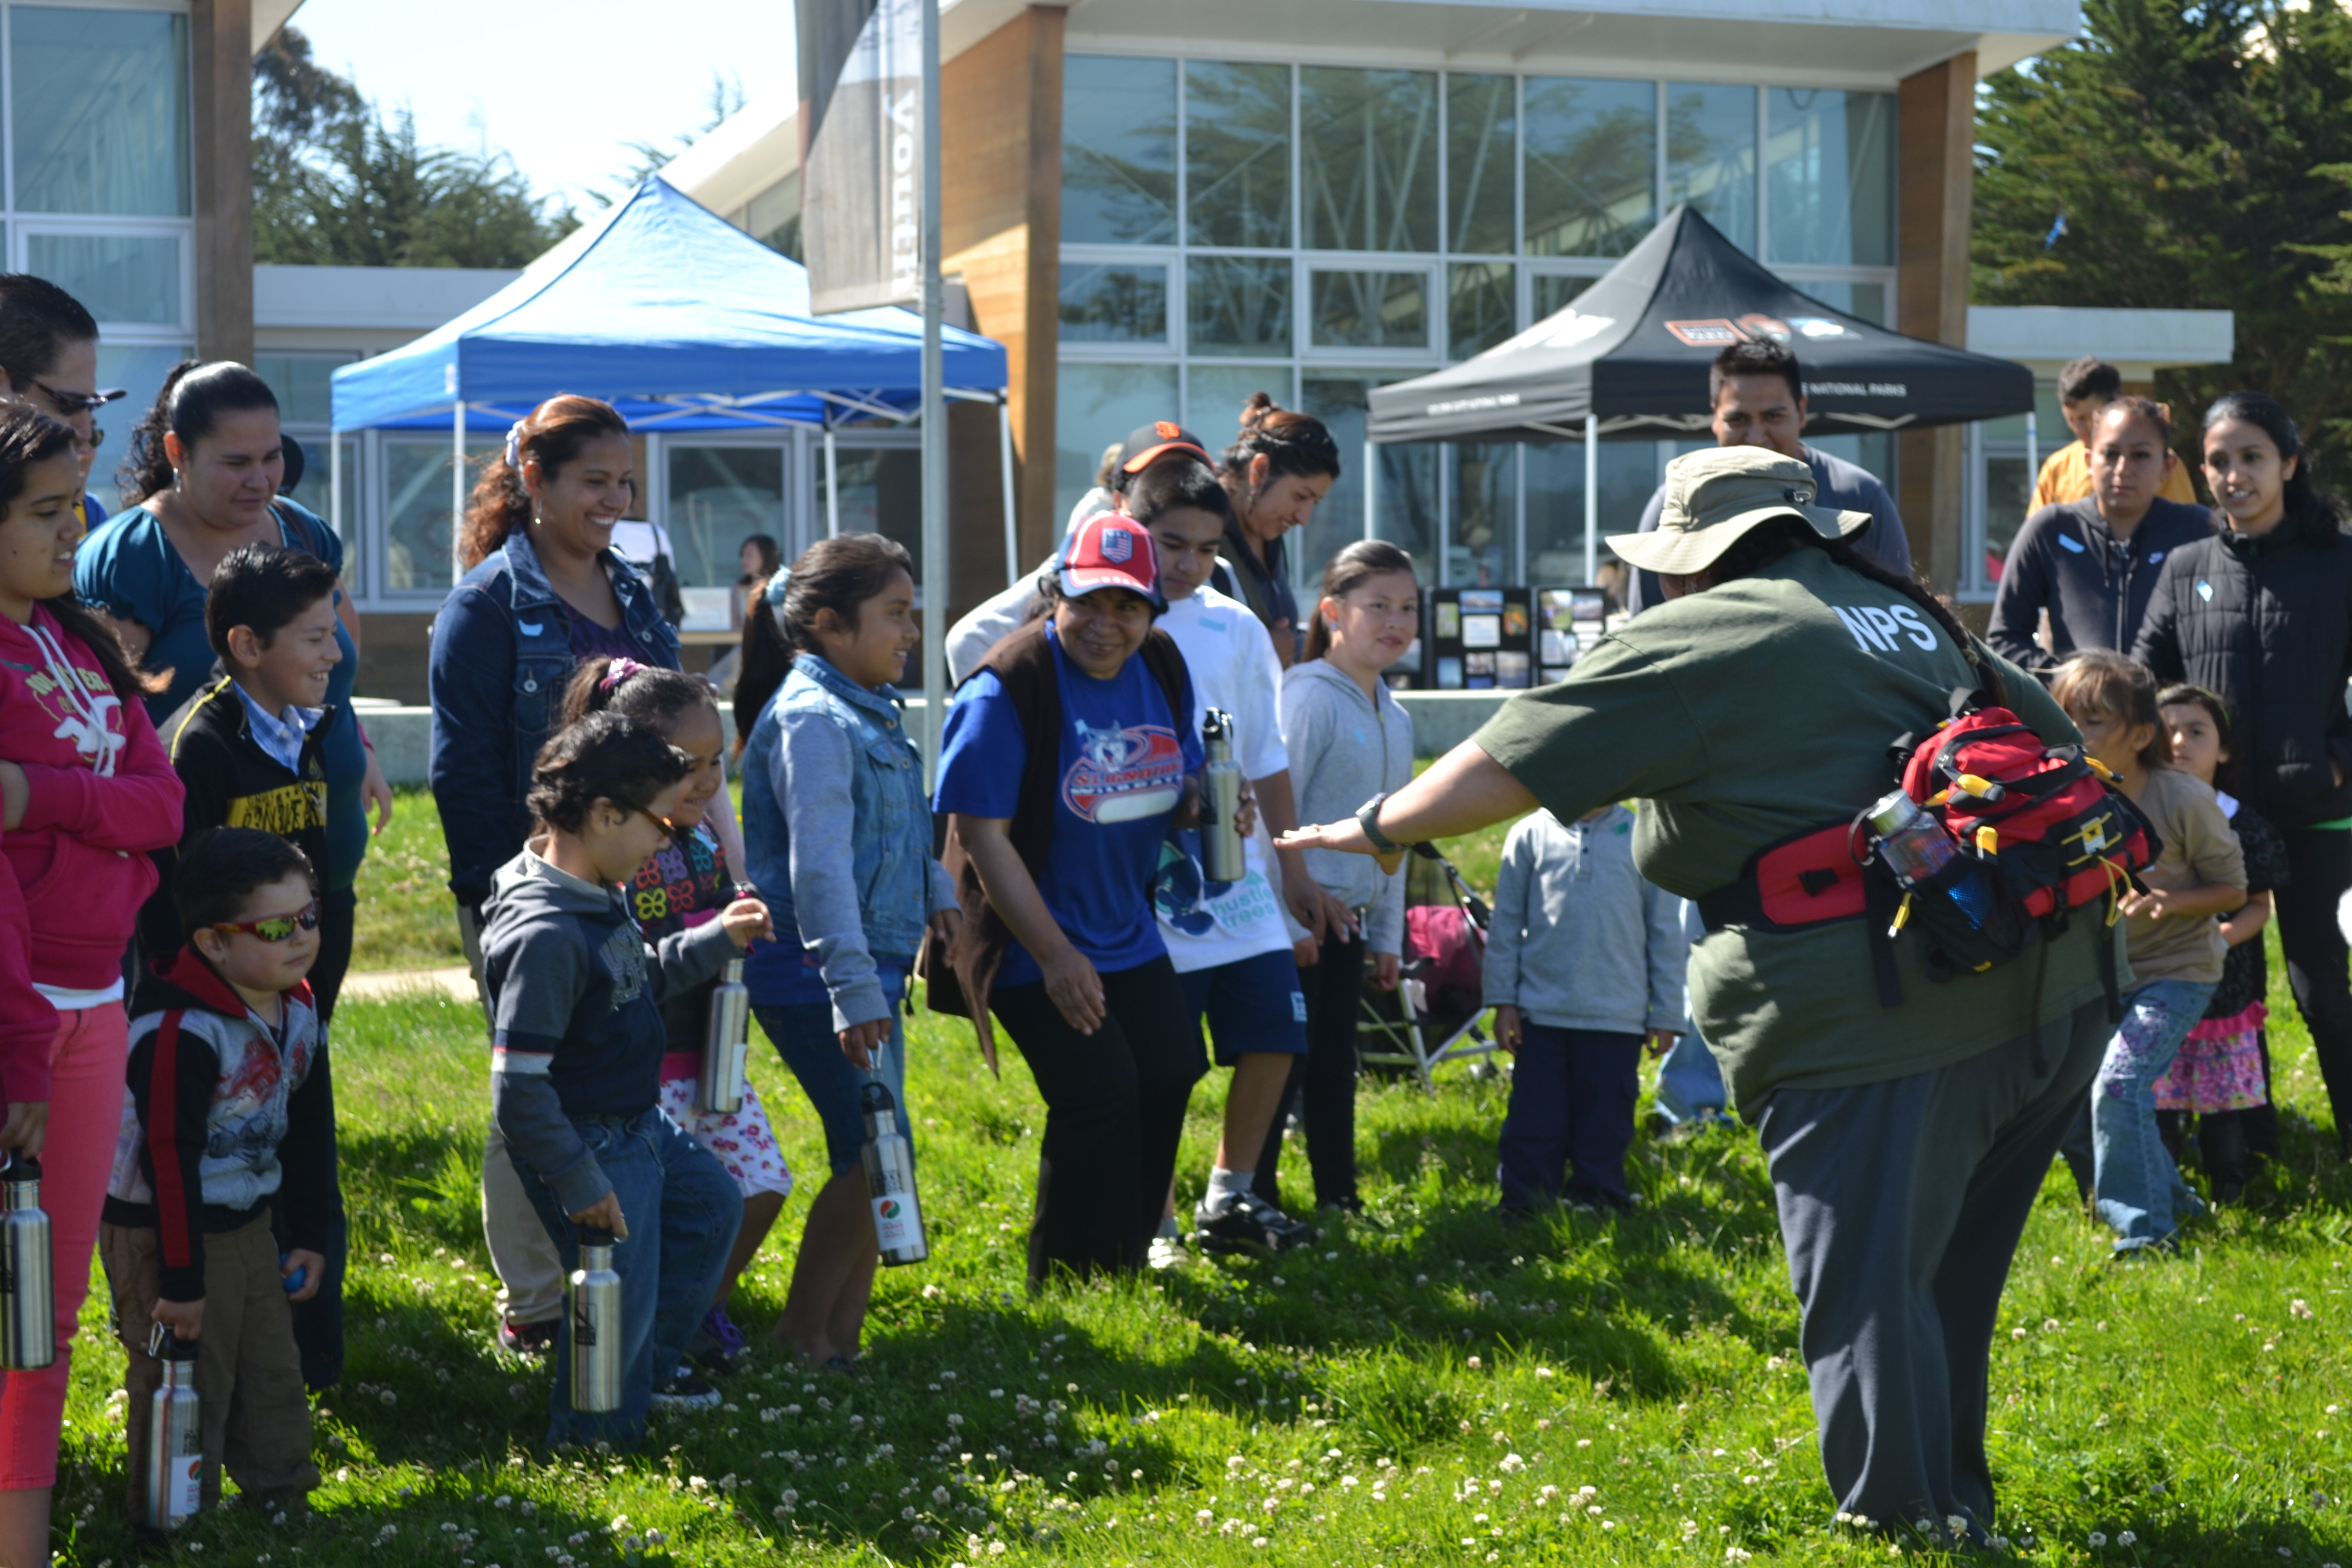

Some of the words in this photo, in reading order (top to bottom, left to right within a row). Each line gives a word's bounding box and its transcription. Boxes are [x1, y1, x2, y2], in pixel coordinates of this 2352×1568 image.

[884, 89, 919, 296] youth
[1810, 382, 1867, 397] NATIONAL
[1868, 383, 1908, 398] PARKS
[1831, 604, 1938, 652] NPS
[1211, 877, 1273, 918] hustle
[1221, 901, 1276, 929] trees
